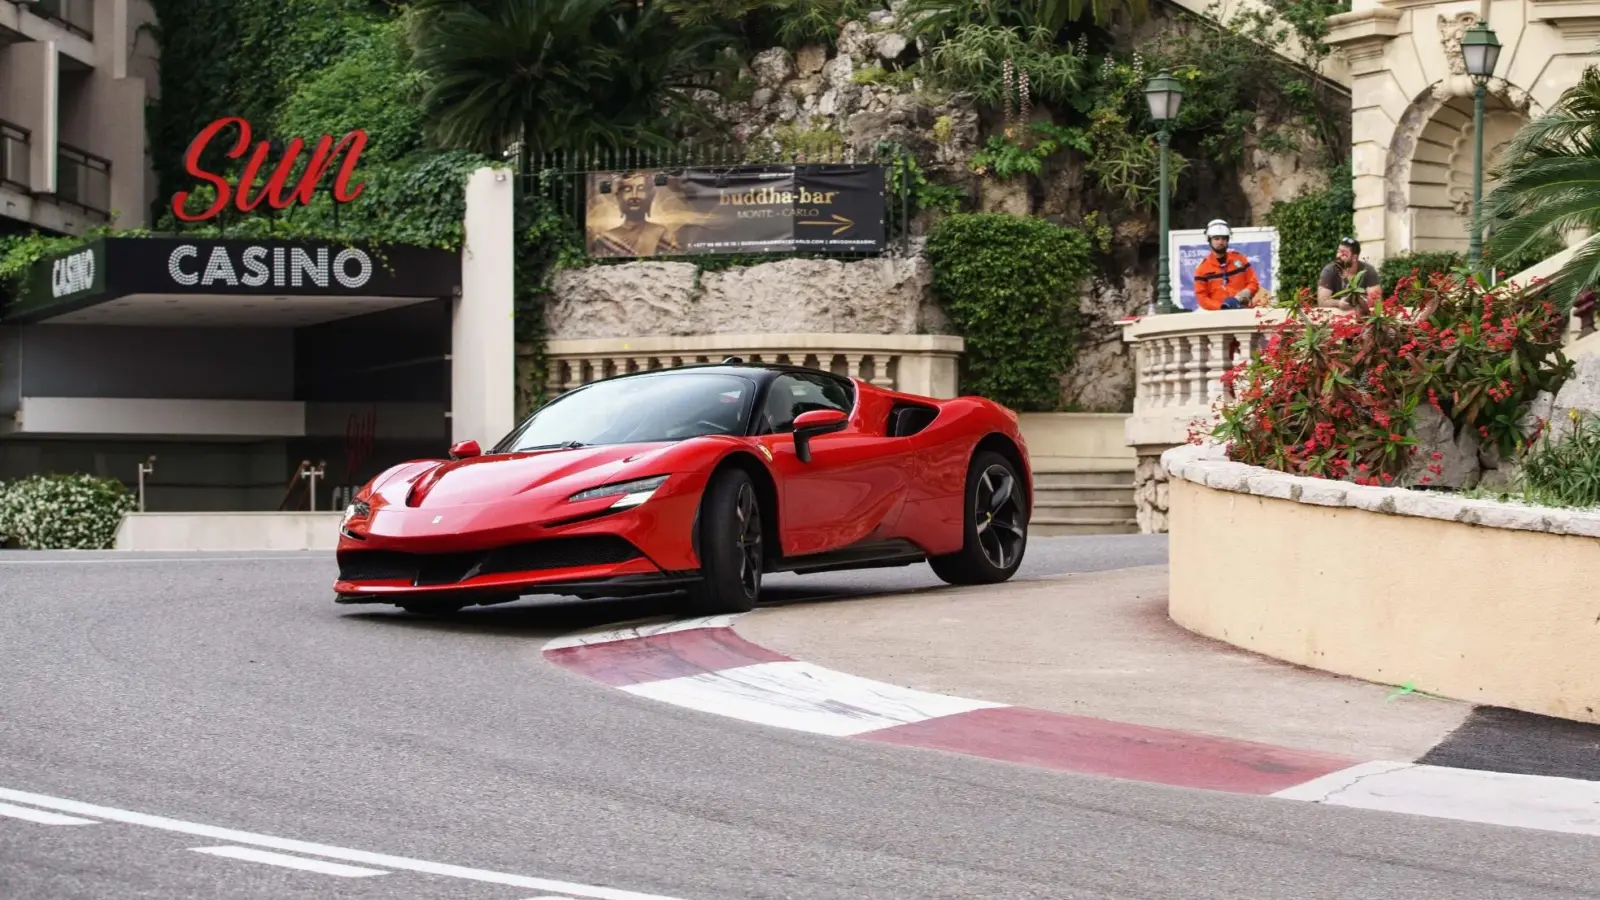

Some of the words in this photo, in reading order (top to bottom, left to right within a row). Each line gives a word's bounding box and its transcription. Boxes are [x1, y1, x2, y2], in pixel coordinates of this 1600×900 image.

[171, 116, 368, 221] Sun
[719, 187, 836, 205] buddha-bar
[737, 210, 773, 218] MONTE
[781, 208, 819, 217] CARLO
[52, 249, 94, 297] CASINO
[168, 244, 373, 288] CASINO
